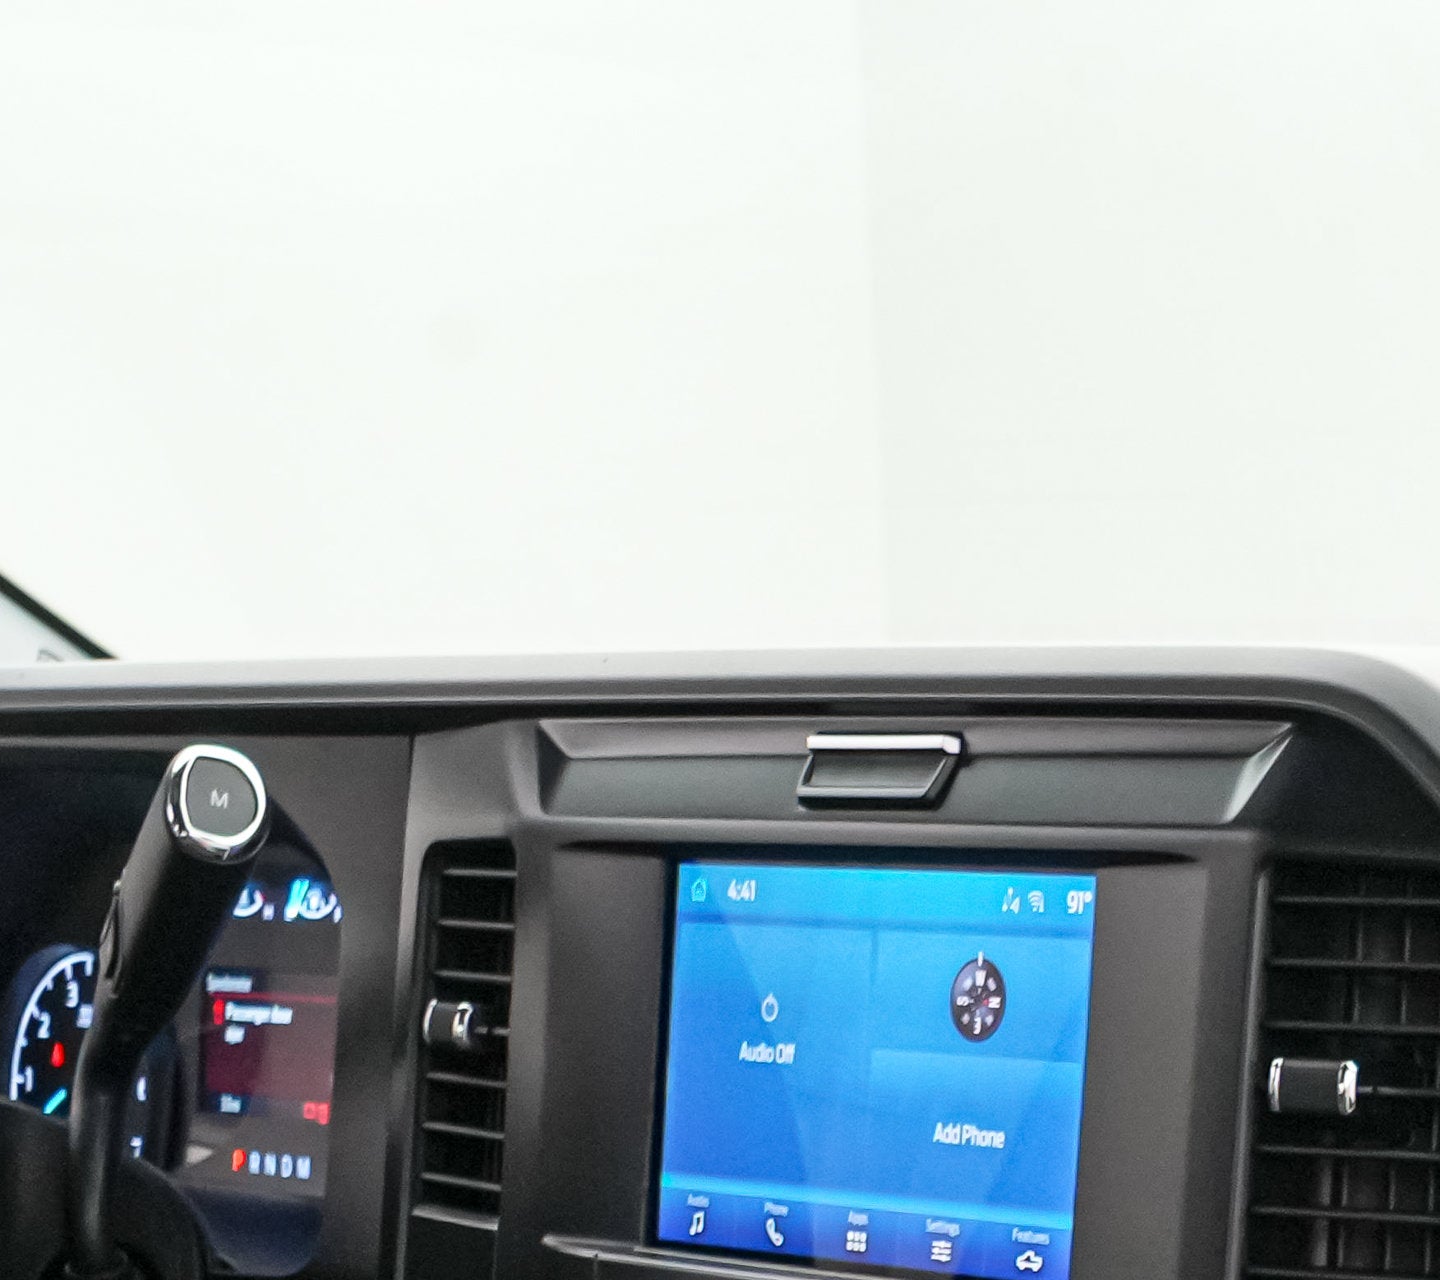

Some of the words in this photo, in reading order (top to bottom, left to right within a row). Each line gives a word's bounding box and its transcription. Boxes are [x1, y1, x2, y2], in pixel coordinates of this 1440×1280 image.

[210, 788, 229, 810] M
[66, 980, 79, 1009] 3
[738, 1040, 775, 1064] Audio
[775, 1043, 796, 1065] Off
[932, 1121, 961, 1145] Add
[961, 1123, 1006, 1150] Phone
